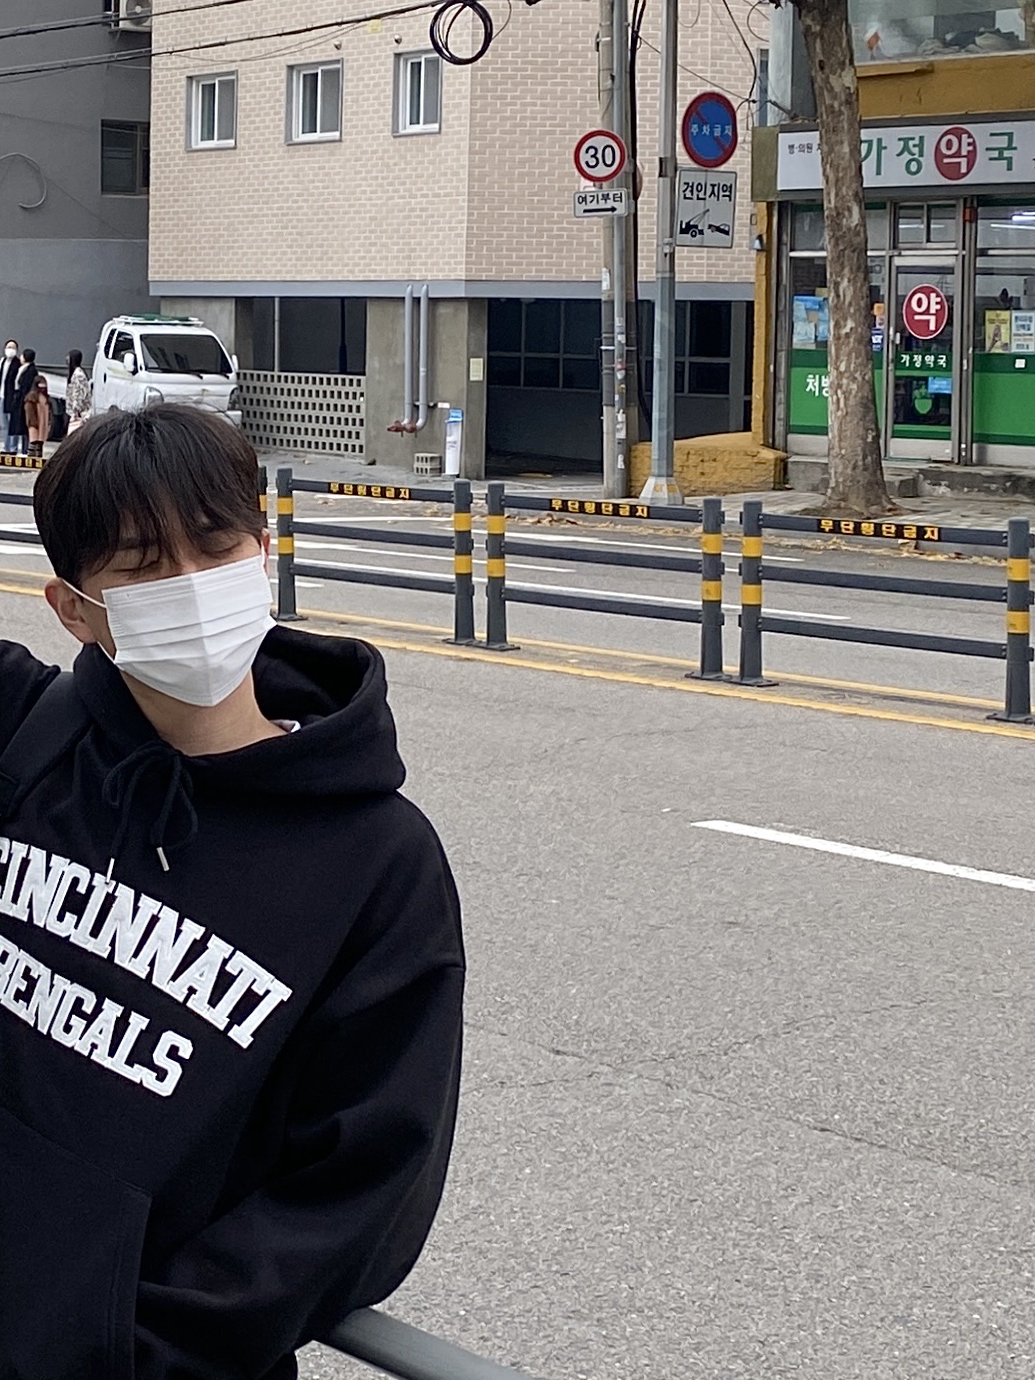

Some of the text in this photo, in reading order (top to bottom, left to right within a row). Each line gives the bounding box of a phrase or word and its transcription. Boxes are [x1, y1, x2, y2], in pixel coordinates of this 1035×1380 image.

[690, 124, 733, 137] 주차금지
[584, 144, 616, 169] 30
[861, 131, 1018, 176] 가정약국
[577, 192, 624, 206] 여기부터
[681, 181, 734, 202] 견인지역
[910, 292, 942, 331] 약
[900, 354, 947, 368] 가정약국
[550, 498, 649, 518] 무단횡단금지
[820, 519, 940, 541] 무단횡단금지
